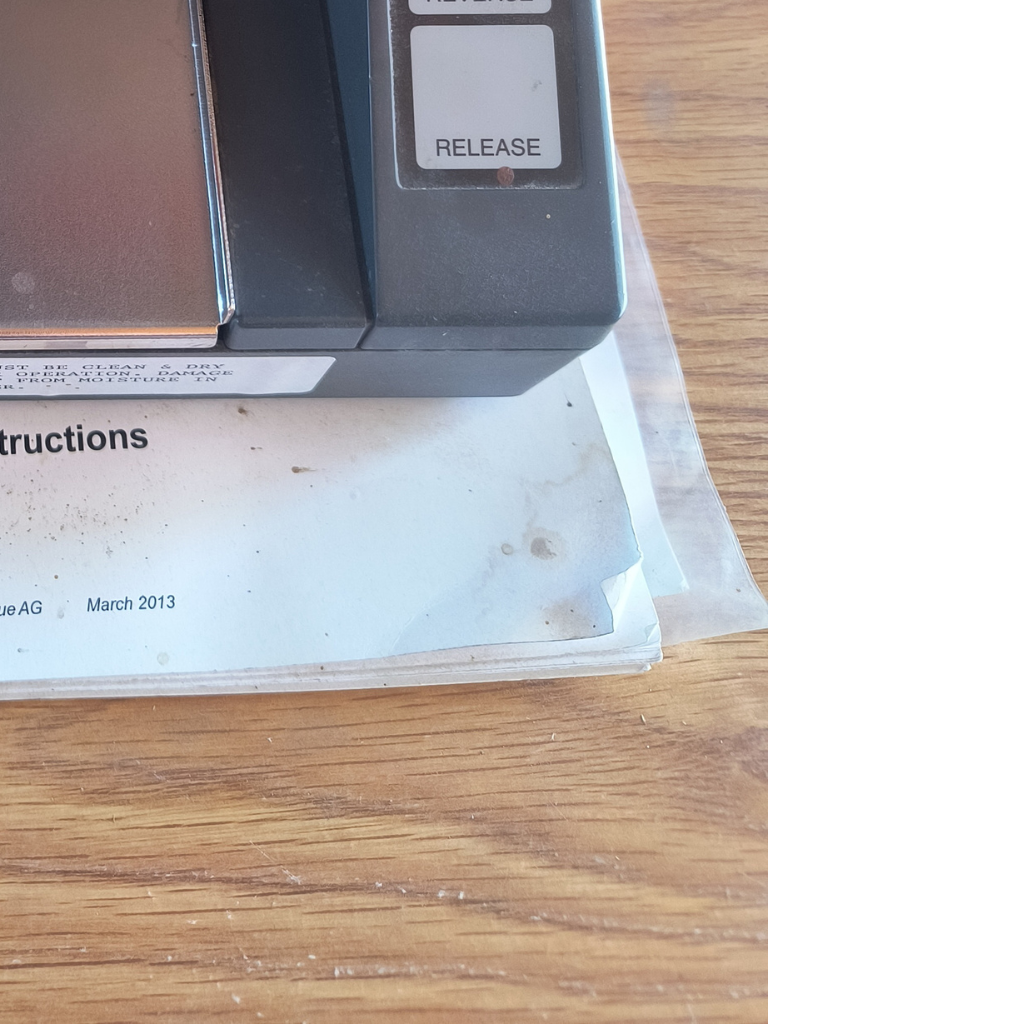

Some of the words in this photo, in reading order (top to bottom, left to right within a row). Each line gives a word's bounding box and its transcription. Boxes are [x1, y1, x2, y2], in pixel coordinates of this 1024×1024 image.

[435, 138, 541, 157] RELEASE
[17, 600, 44, 617] AG
[86, 596, 134, 613] March
[138, 595, 176, 610] 2013
